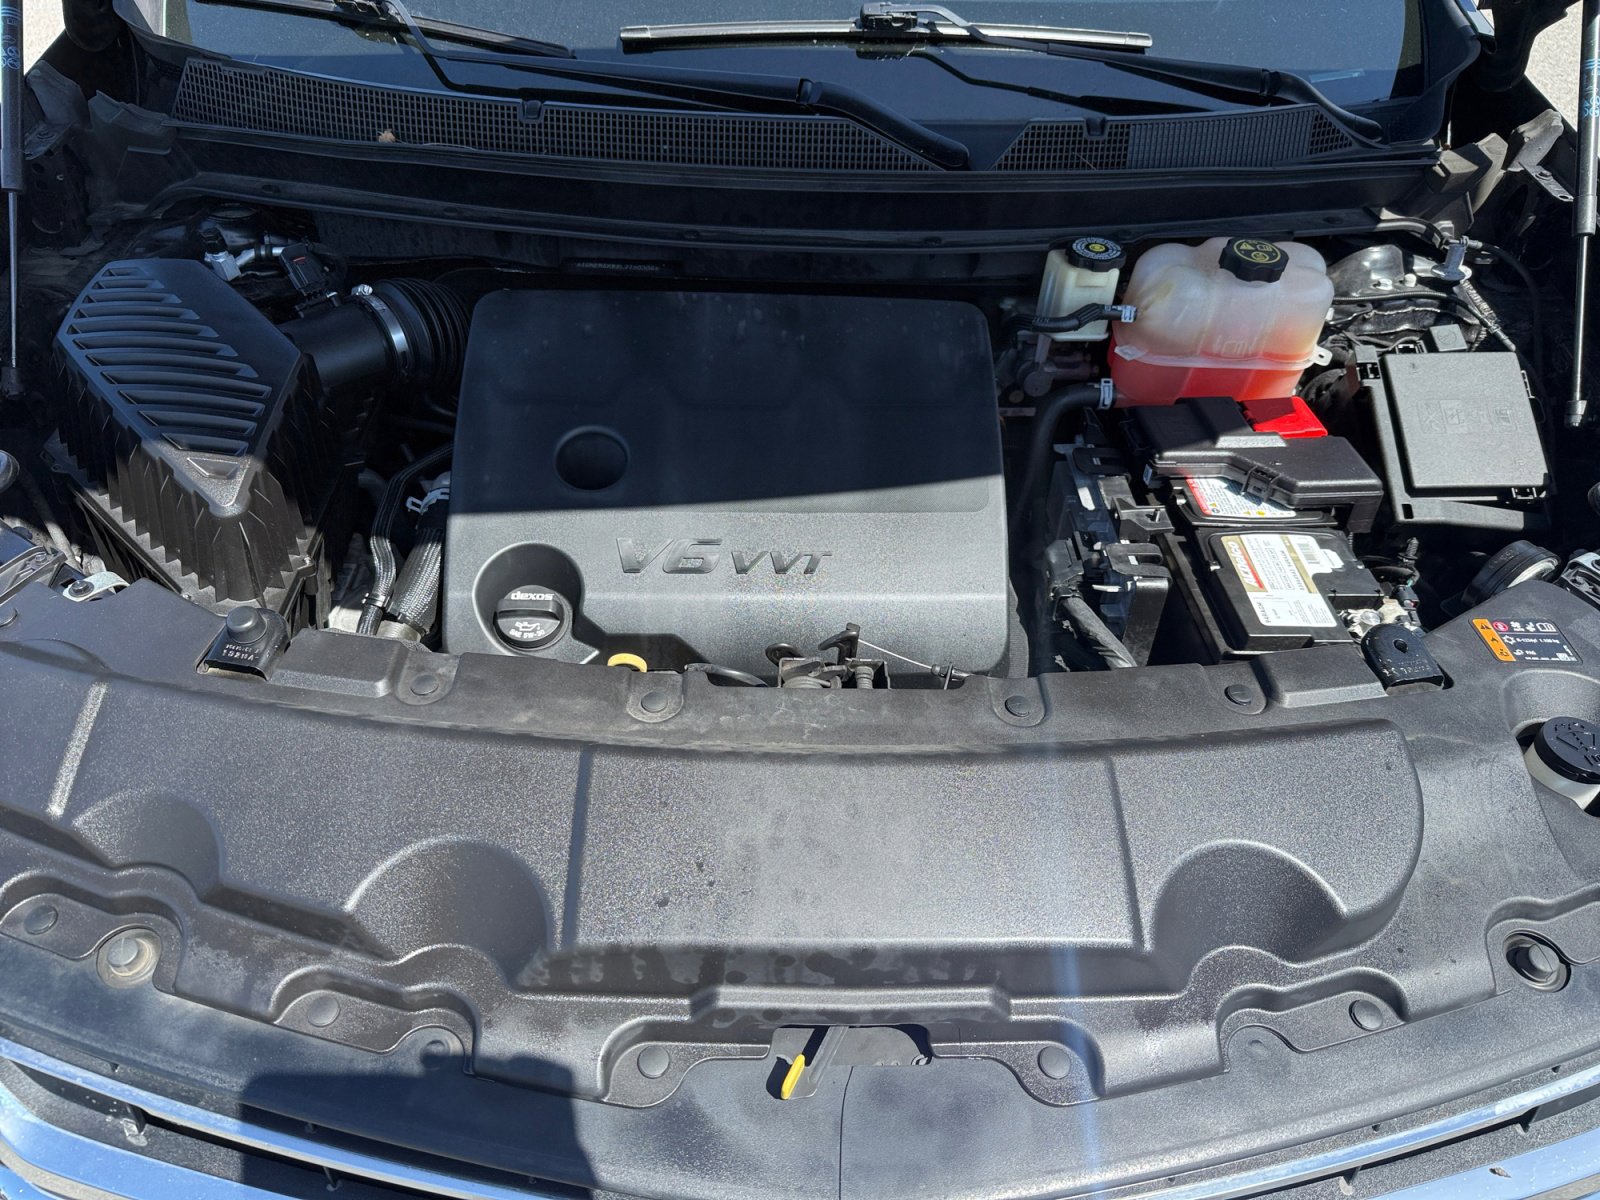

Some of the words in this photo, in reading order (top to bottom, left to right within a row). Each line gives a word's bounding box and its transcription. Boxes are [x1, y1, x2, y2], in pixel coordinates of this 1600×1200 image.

[616, 538, 723, 574] V6
[731, 550, 833, 575] VVT
[511, 591, 554, 601] dexos
